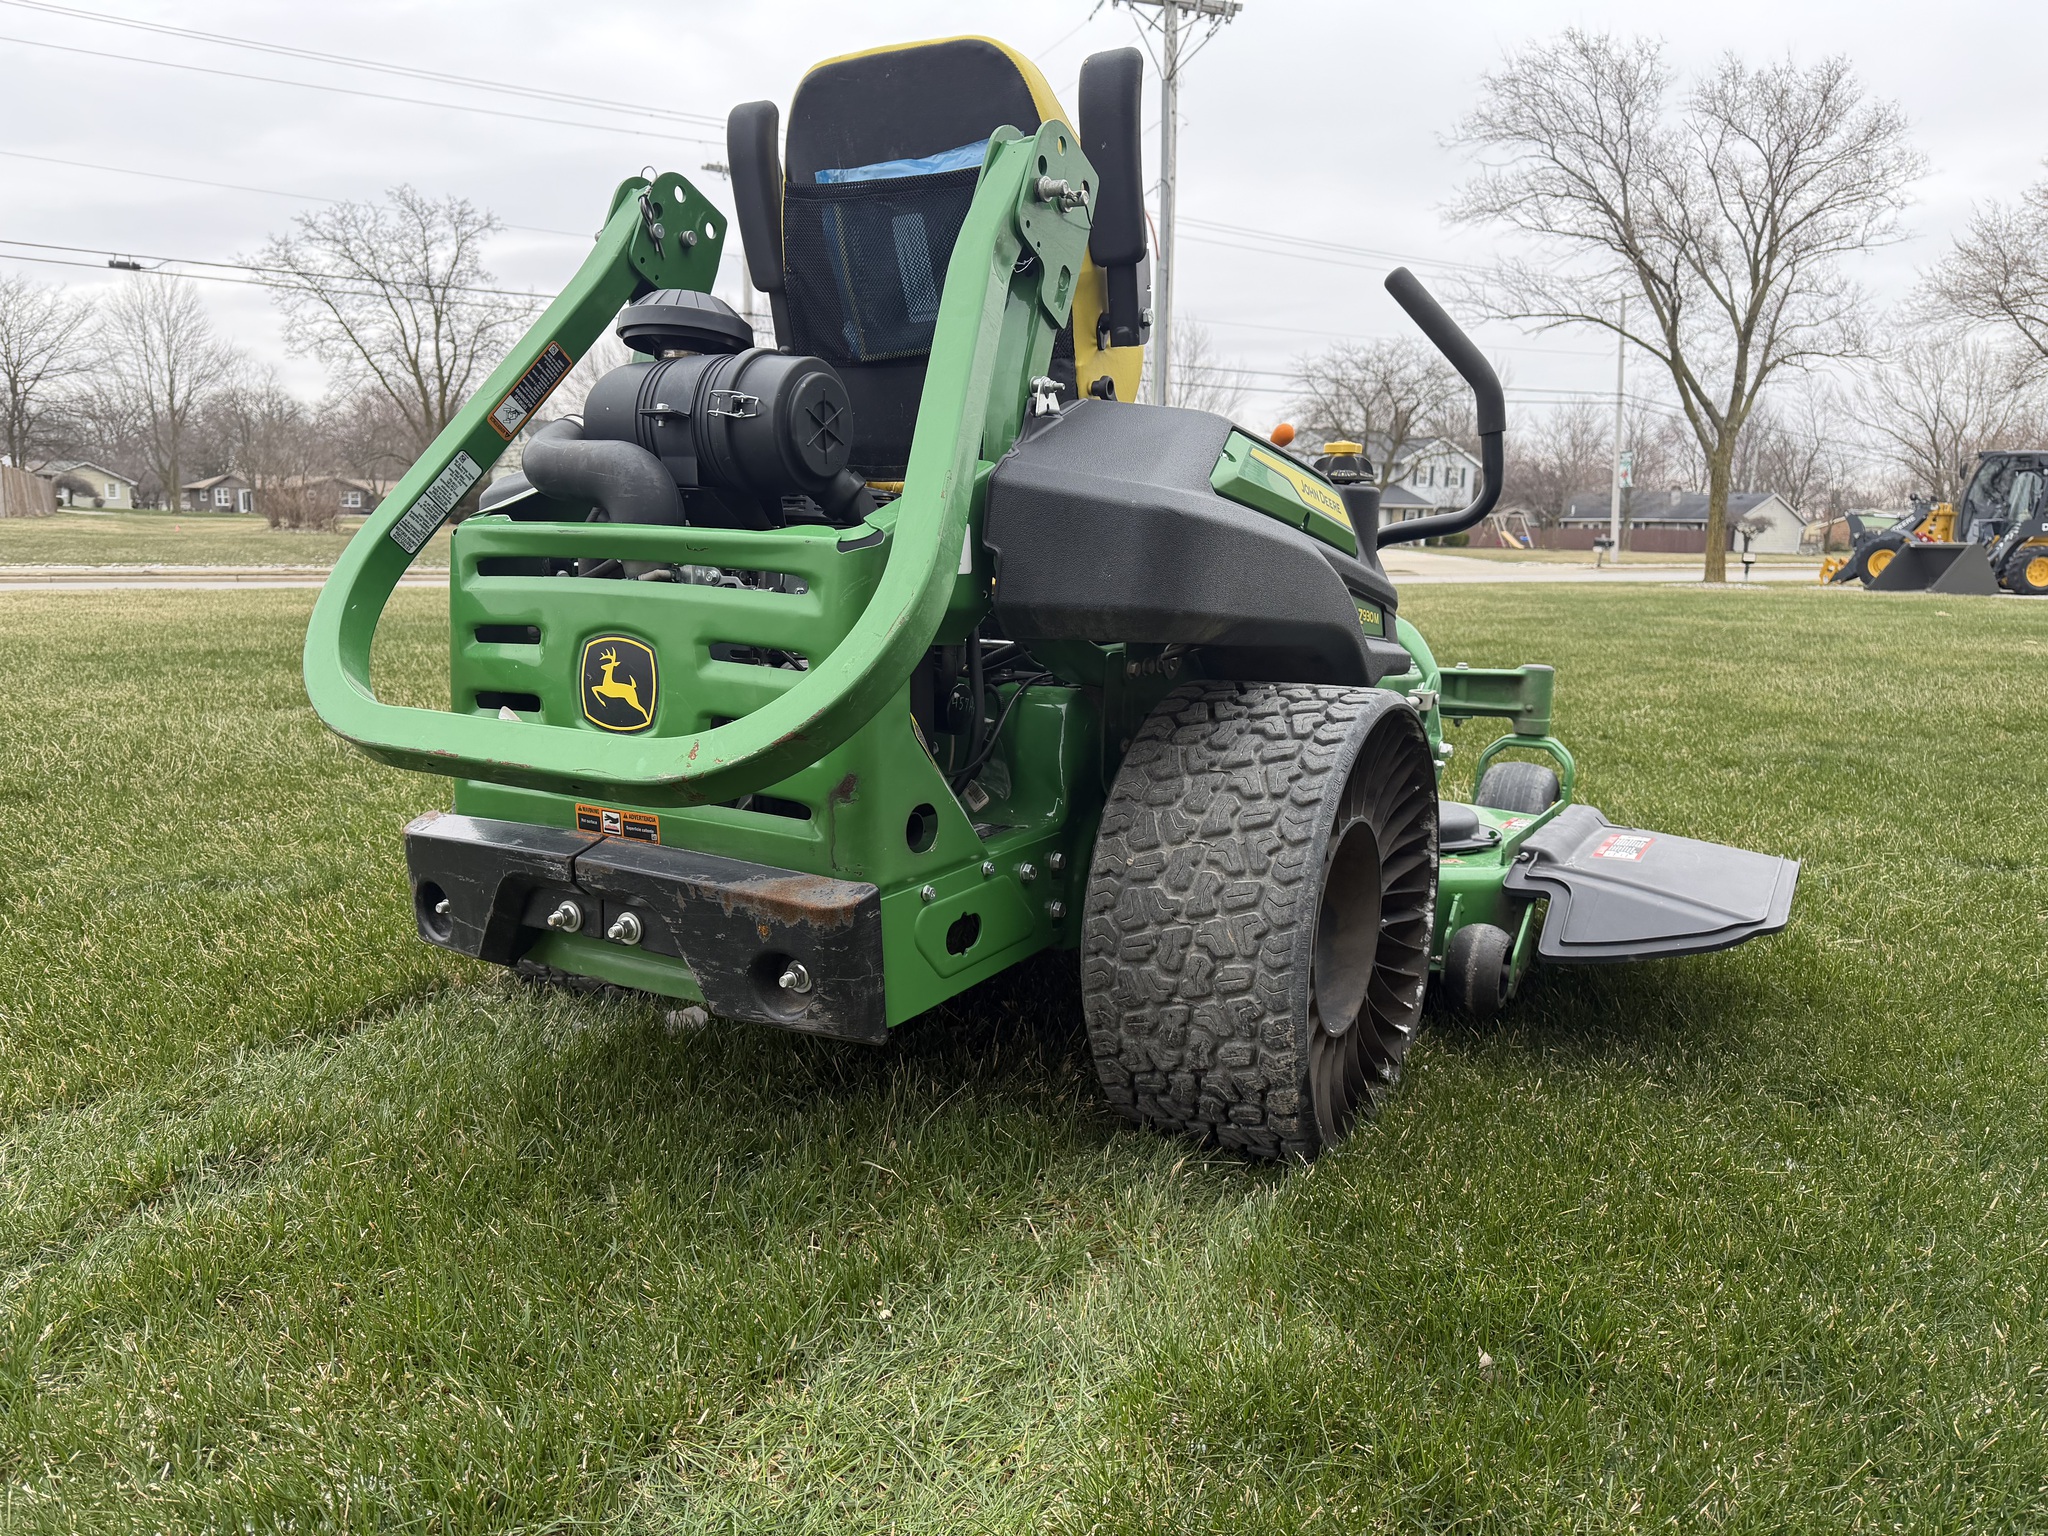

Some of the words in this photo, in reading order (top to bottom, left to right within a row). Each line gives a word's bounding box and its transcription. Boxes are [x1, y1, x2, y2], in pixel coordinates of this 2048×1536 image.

[1301, 480, 1321, 502] JOHN
[1319, 490, 1342, 514] DEERE
[1358, 607, 1380, 625] Z930M
